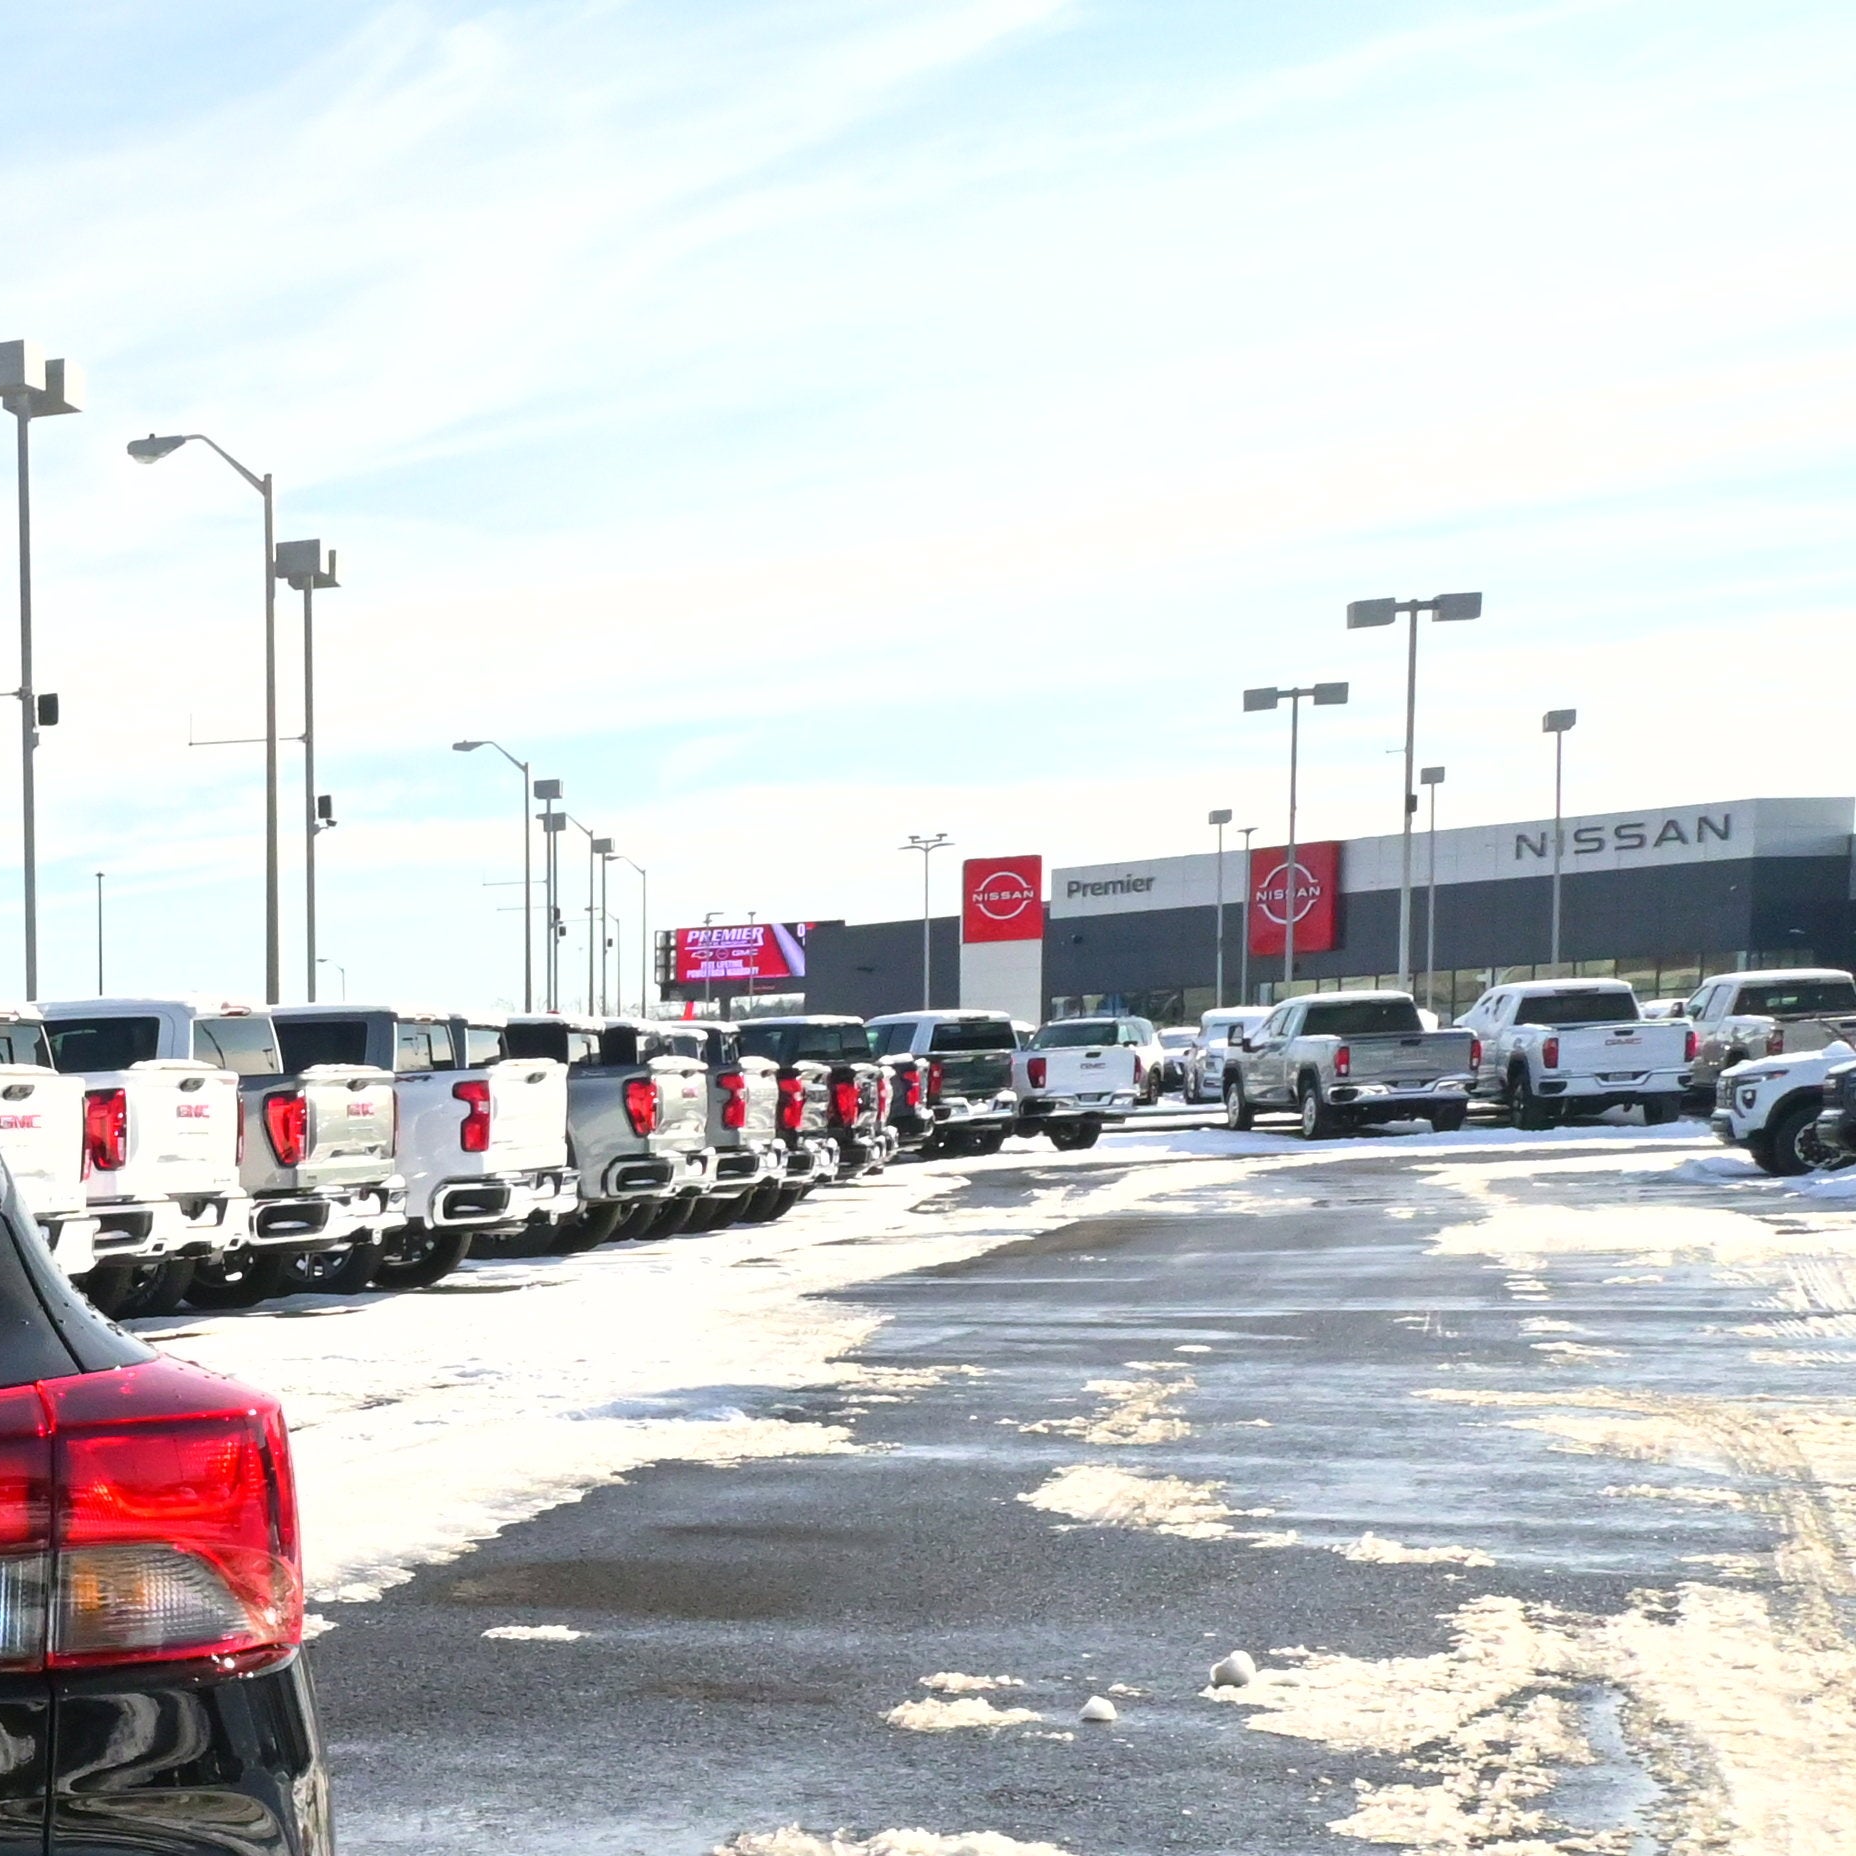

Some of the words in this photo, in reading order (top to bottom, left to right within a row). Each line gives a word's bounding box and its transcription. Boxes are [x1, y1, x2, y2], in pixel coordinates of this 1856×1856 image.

[1515, 813, 1732, 861] NISSAN
[1066, 873, 1155, 899] Premier
[1256, 886, 1321, 902] NISAN
[972, 888, 1035, 903] NISSAN
[687, 926, 764, 944] PREMIER
[176, 1104, 210, 1119] GMC
